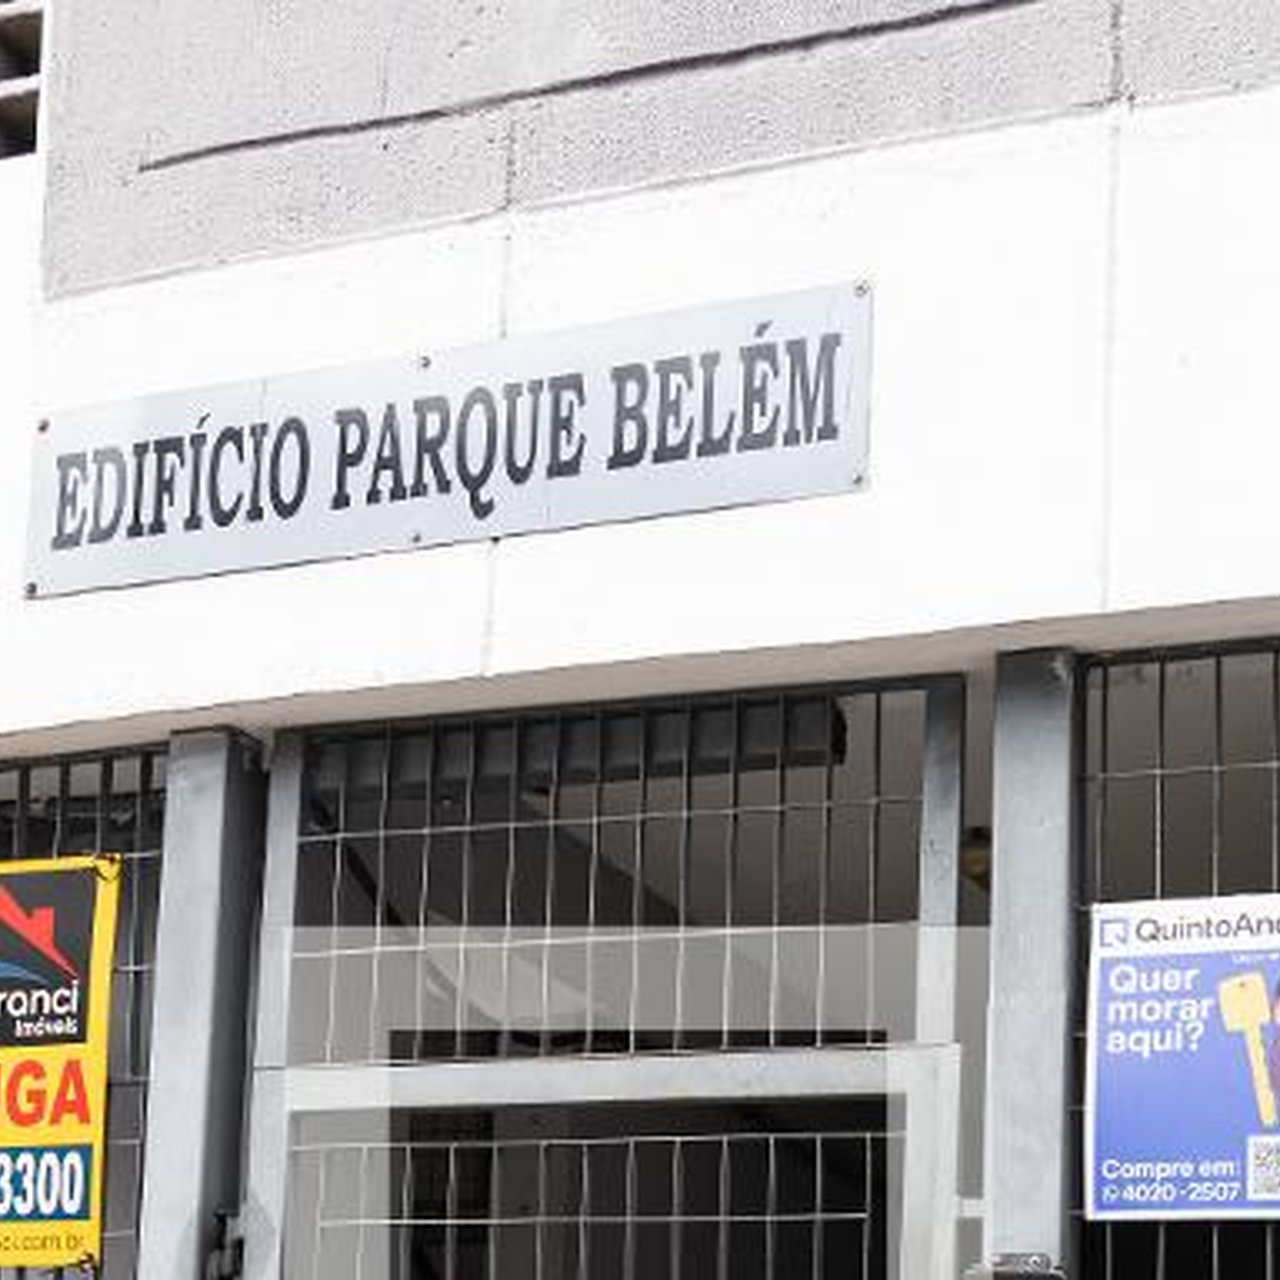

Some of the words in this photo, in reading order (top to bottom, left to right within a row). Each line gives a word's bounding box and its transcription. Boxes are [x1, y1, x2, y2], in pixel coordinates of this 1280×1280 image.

[50, 412, 311, 551] EDIFÍCIO
[330, 373, 588, 521] PARQUE
[606, 320, 843, 472] BELÉM
[1107, 964, 1201, 994] Quer
[1106, 995, 1214, 1023] morar
[1105, 1021, 1206, 1058] aqui?
